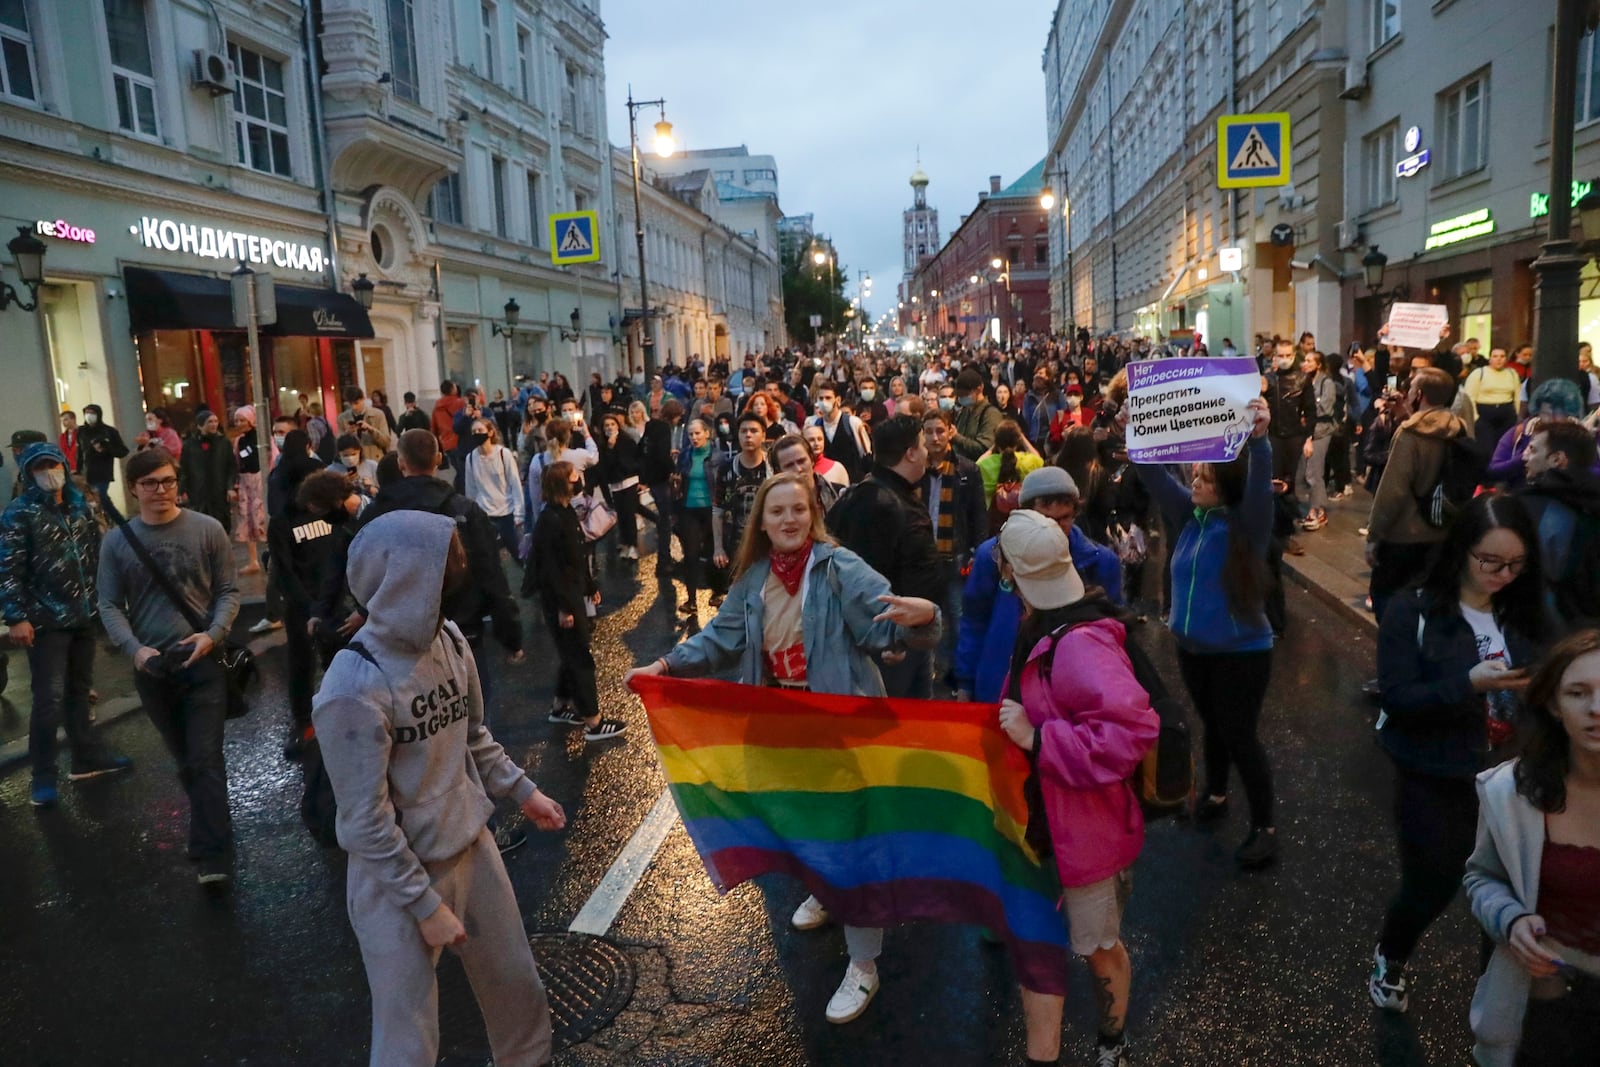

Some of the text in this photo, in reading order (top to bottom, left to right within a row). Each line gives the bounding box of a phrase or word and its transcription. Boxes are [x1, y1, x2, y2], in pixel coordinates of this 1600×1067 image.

[36, 219, 97, 243] re:Store
[141, 215, 323, 273] КОНДИТЕРСКАЯ
[1133, 364, 1155, 377] Нет
[1133, 366, 1204, 388] репрессиям
[1130, 386, 1201, 409] Прекратить
[1131, 396, 1226, 424] преследование
[1133, 409, 1236, 437] Юлии Цветковой
